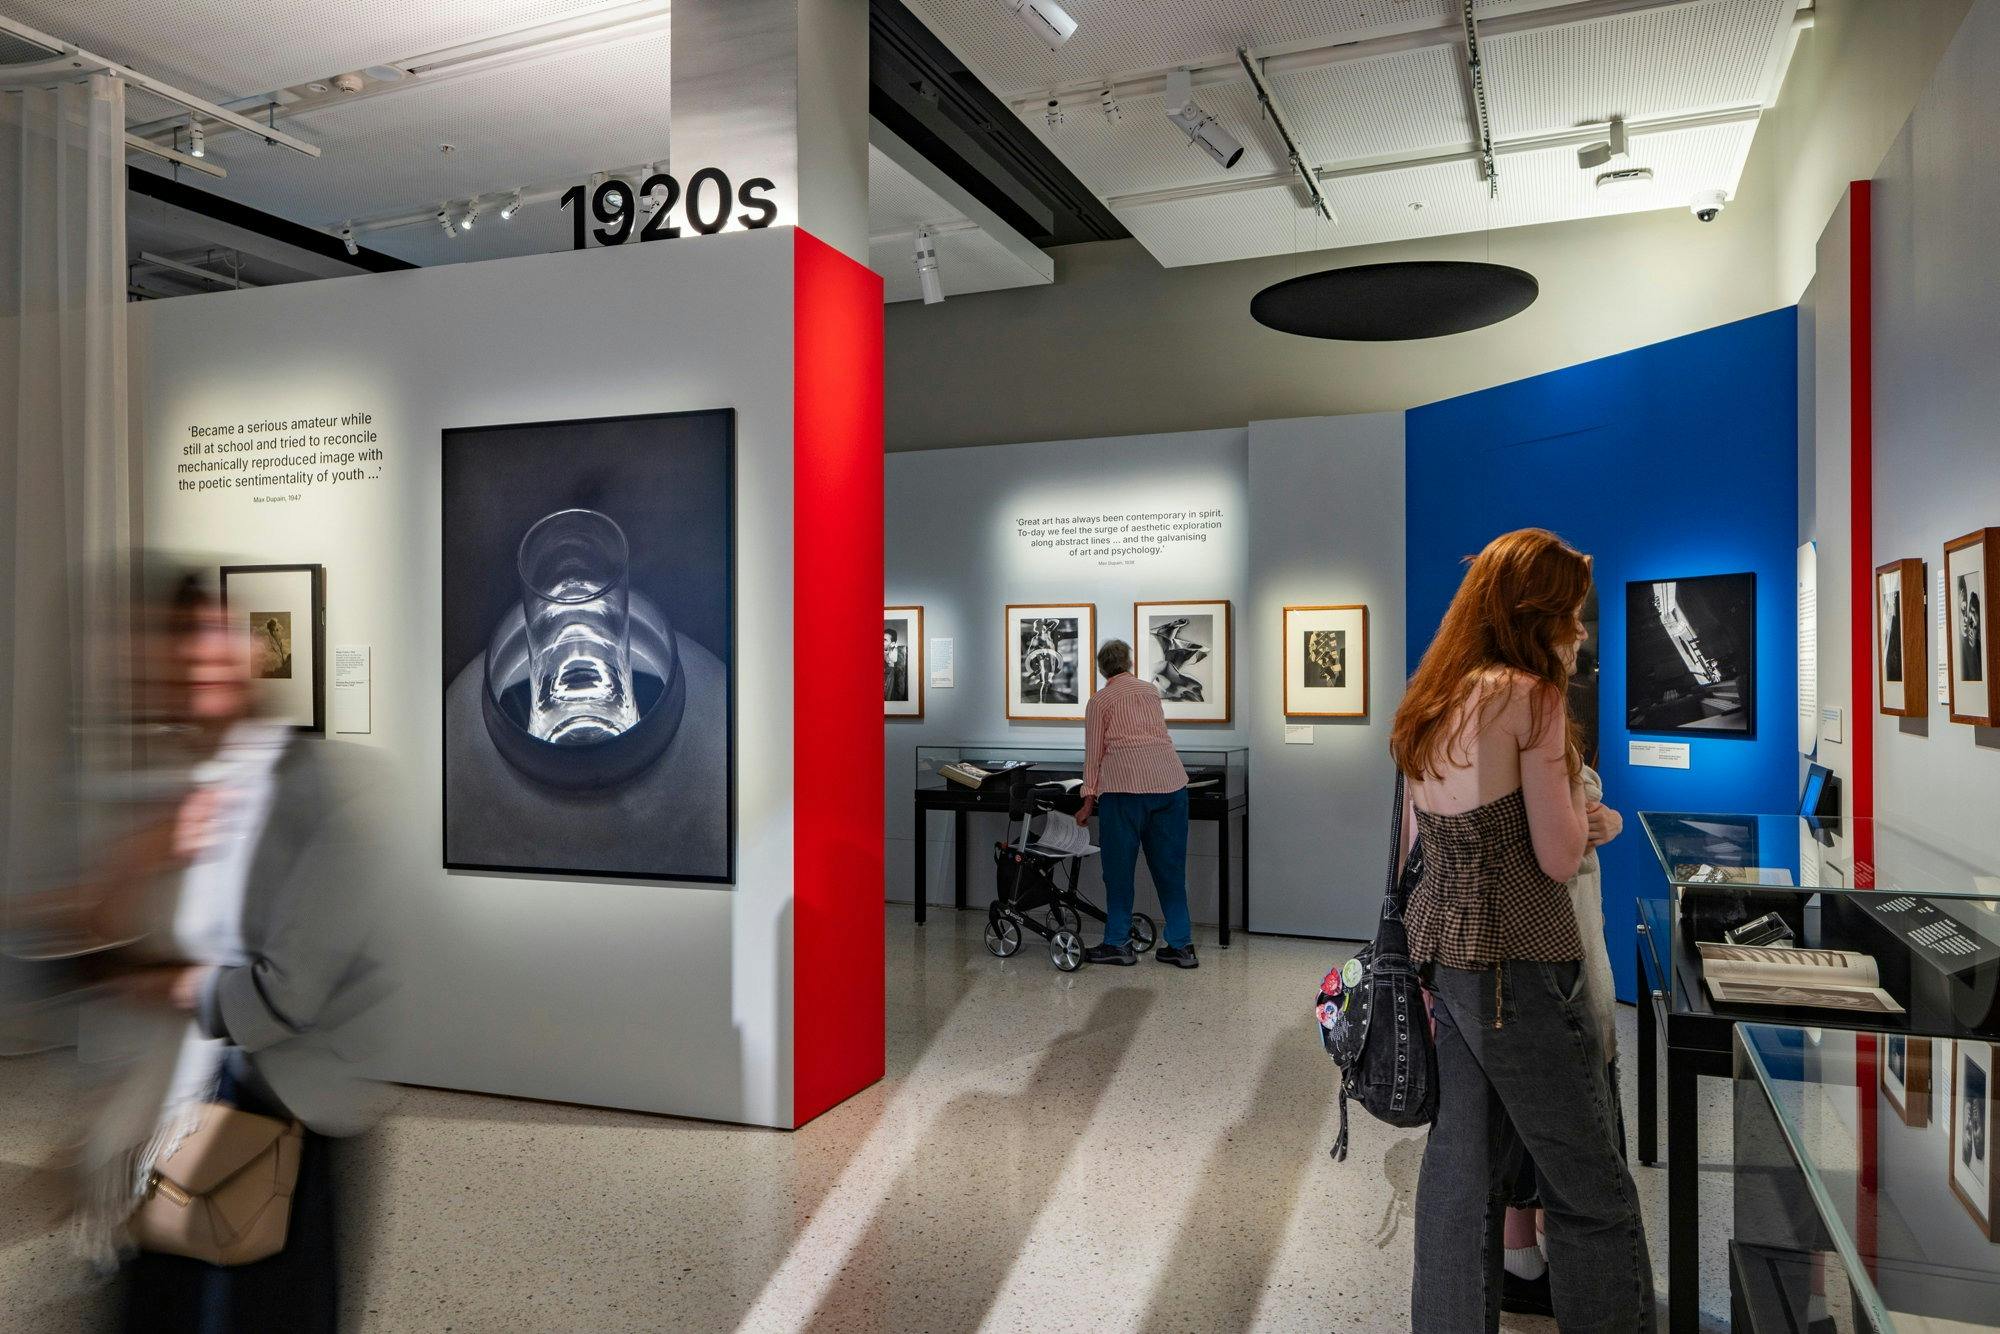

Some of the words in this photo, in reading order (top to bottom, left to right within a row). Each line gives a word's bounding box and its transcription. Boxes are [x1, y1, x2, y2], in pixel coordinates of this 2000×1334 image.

[560, 167, 778, 250] 1920s
[237, 425, 244, 434] a
[247, 419, 288, 433] serious
[290, 415, 338, 430] amateur
[341, 412, 372, 426] while
[183, 443, 201, 456] still
[204, 443, 214, 454] at
[217, 439, 253, 453] school
[256, 437, 277, 452] and
[280, 435, 306, 449] tried
[309, 435, 320, 447] to
[323, 430, 377, 446] reconcile
[177, 457, 249, 474] mechanically
[251, 453, 316, 470] reproduced
[319, 450, 355, 465] image
[358, 448, 383, 461] with
[178, 479, 196, 491] the
[198, 476, 232, 492] poetic
[235, 471, 313, 487] sentimentality
[316, 469, 328, 482] of
[331, 467, 365, 485] youth
[1041, 517, 1054, 525] art
[1055, 516, 1070, 525] has
[1072, 515, 1101, 525] always
[1102, 514, 1124, 523] been
[1125, 510, 1186, 522] contemporary
[1188, 510, 1197, 518] in
[1198, 509, 1224, 519] spirit.
[1018, 527, 1045, 538] To-day
[1048, 528, 1060, 536] we
[1061, 525, 1077, 535] feel
[1078, 525, 1092, 534] the
[1094, 525, 1118, 535] surge
[1120, 524, 1129, 532] of
[1131, 522, 1171, 532] aesthetic
[1172, 520, 1222, 531] exploration
[1031, 537, 1053, 548] along
[1055, 536, 1089, 546] abstract
[1090, 535, 1111, 545] lines
[1122, 534, 1139, 543] and
[1140, 534, 1155, 543] the
[1156, 532, 1207, 543] galvanising
[1069, 547, 1078, 556] of
[1079, 547, 1092, 555] art
[1093, 546, 1109, 555] and
